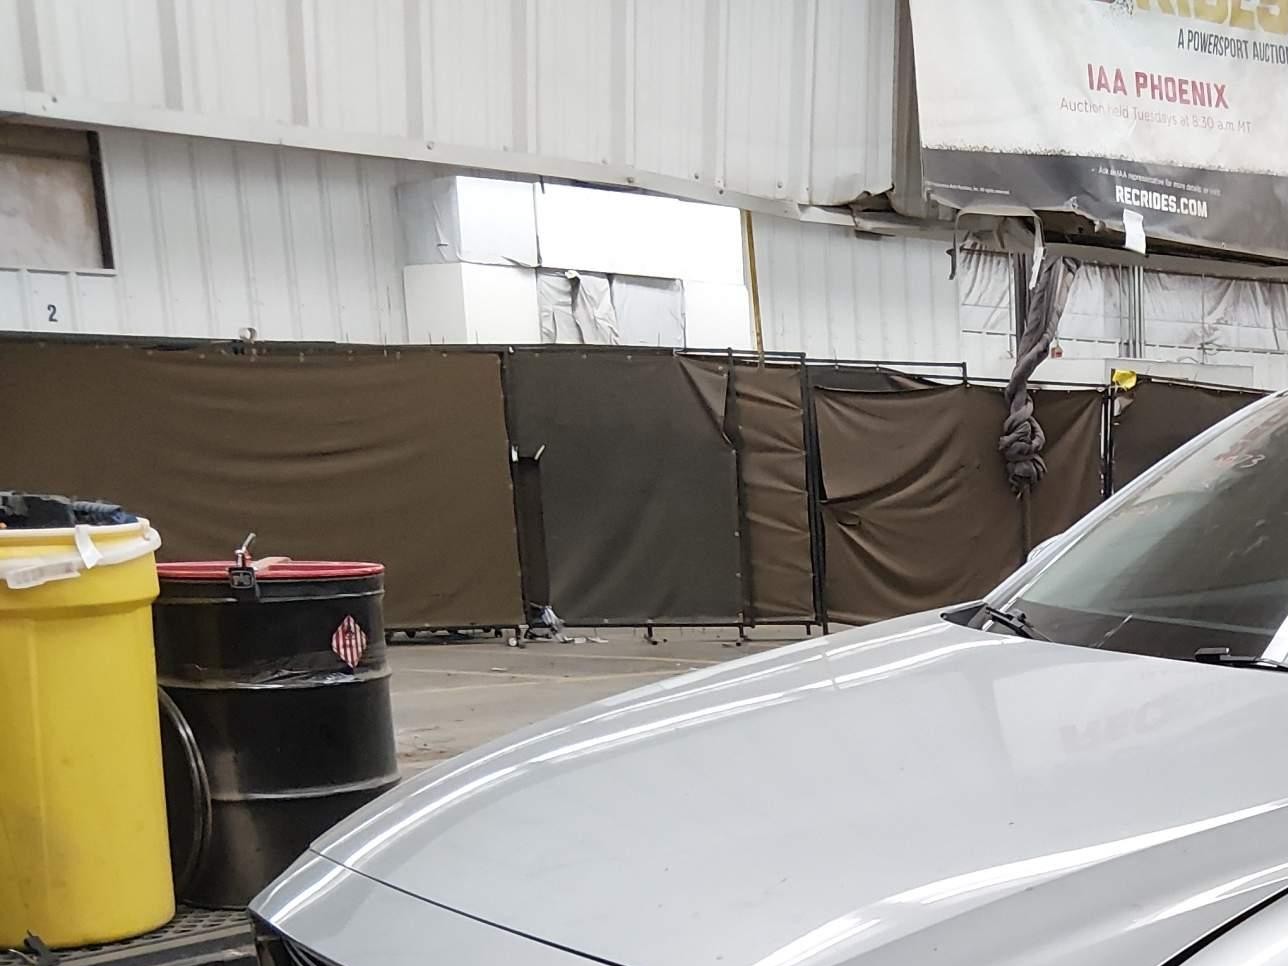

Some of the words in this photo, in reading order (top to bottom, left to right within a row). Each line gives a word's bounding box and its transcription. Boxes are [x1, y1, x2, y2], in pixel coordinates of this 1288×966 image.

[1177, 28, 1185, 49] A
[1187, 29, 1249, 59] POWERSPORT
[1086, 63, 1128, 97] IAA
[1134, 71, 1230, 109] PHOENIX
[1060, 97, 1105, 114] Auction
[1115, 185, 1208, 218] RECRIDES.COM
[47, 304, 59, 322] 2
